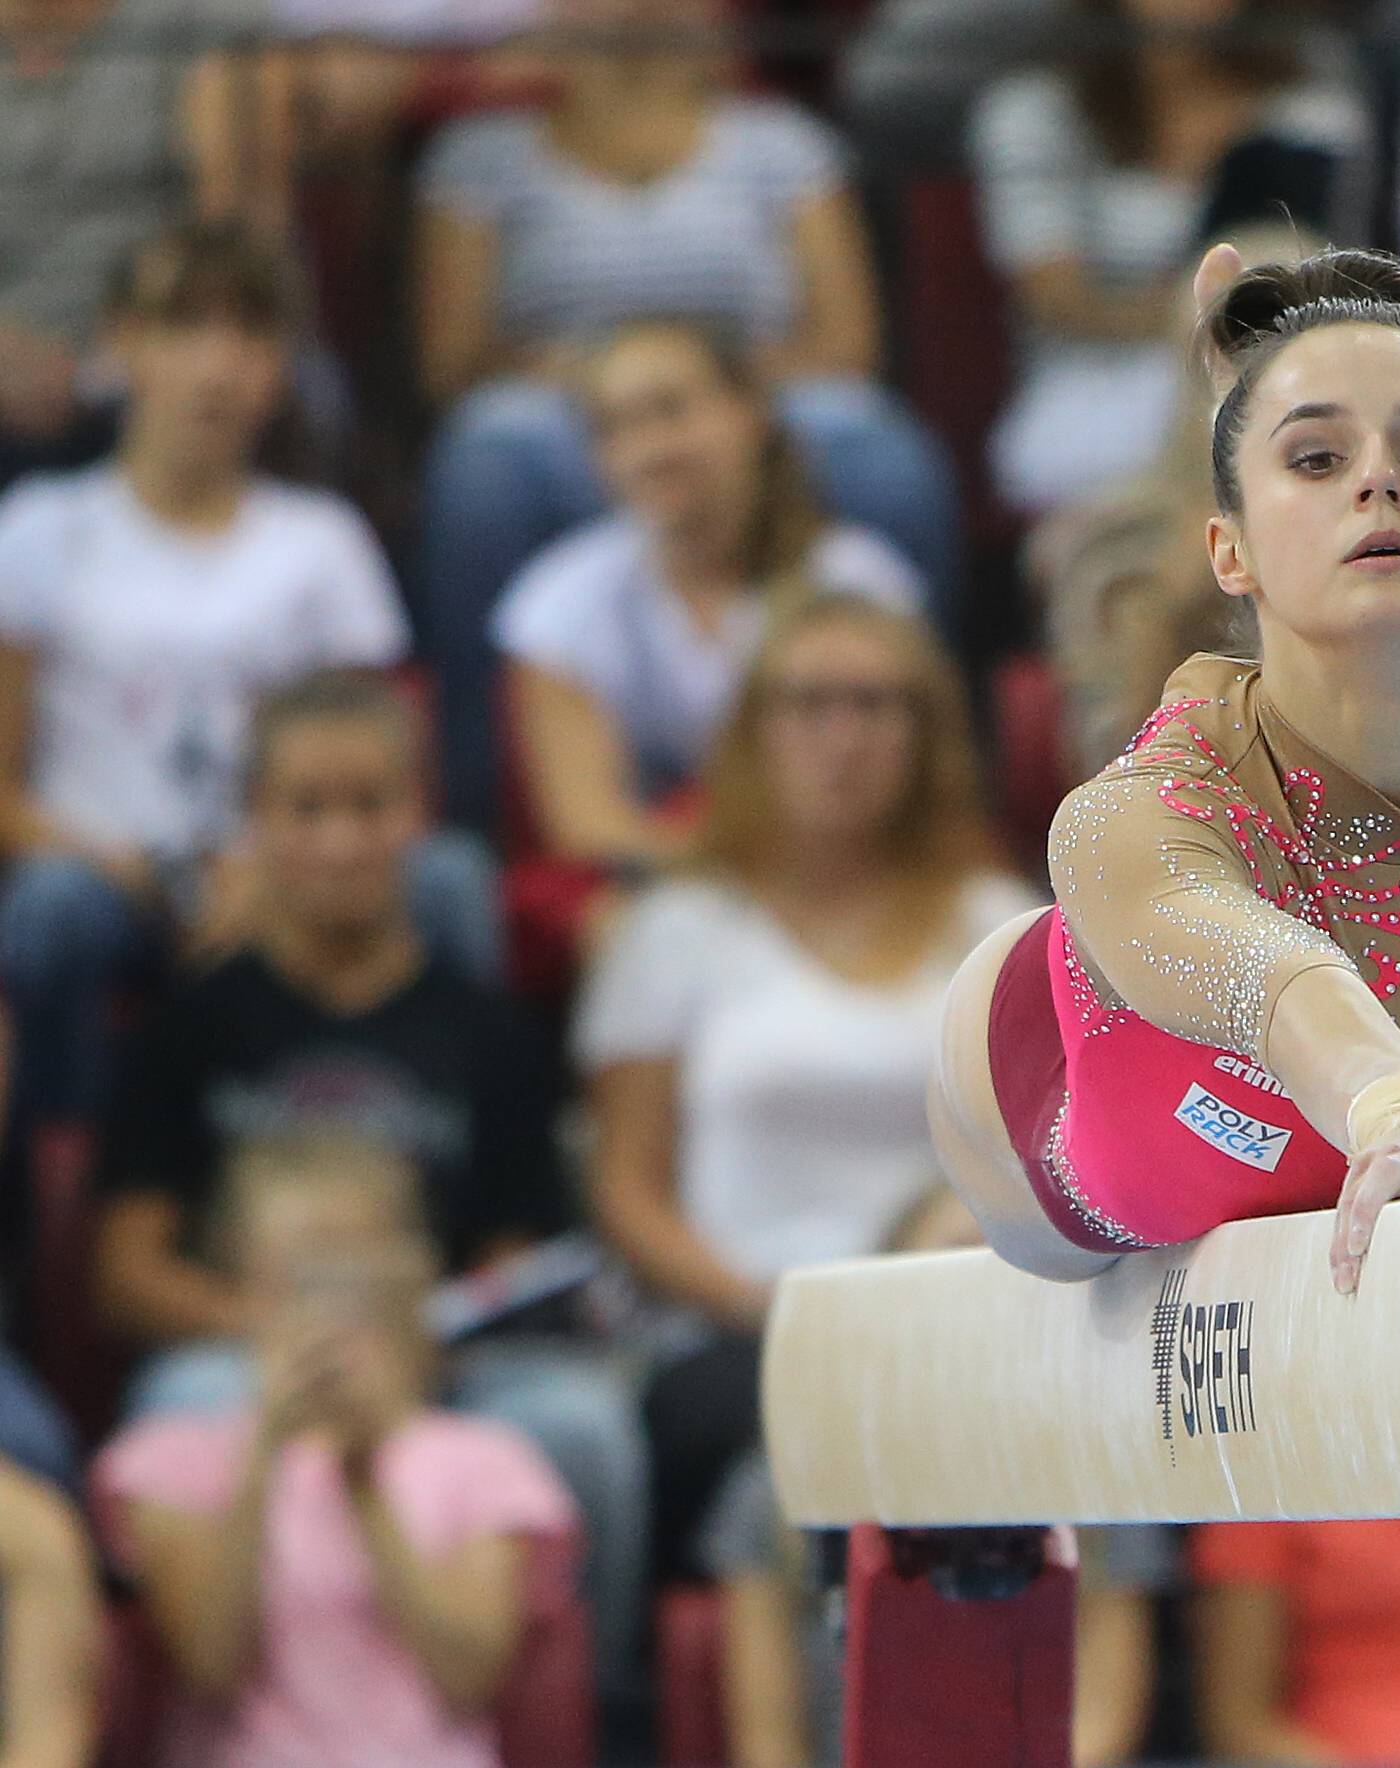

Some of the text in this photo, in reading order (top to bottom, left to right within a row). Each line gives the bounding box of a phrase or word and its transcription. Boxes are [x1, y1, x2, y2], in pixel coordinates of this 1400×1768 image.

[1182, 1105, 1272, 1159] RACK
[1196, 1095, 1288, 1141] POLY
[1180, 1302, 1256, 1438] SPIETH
